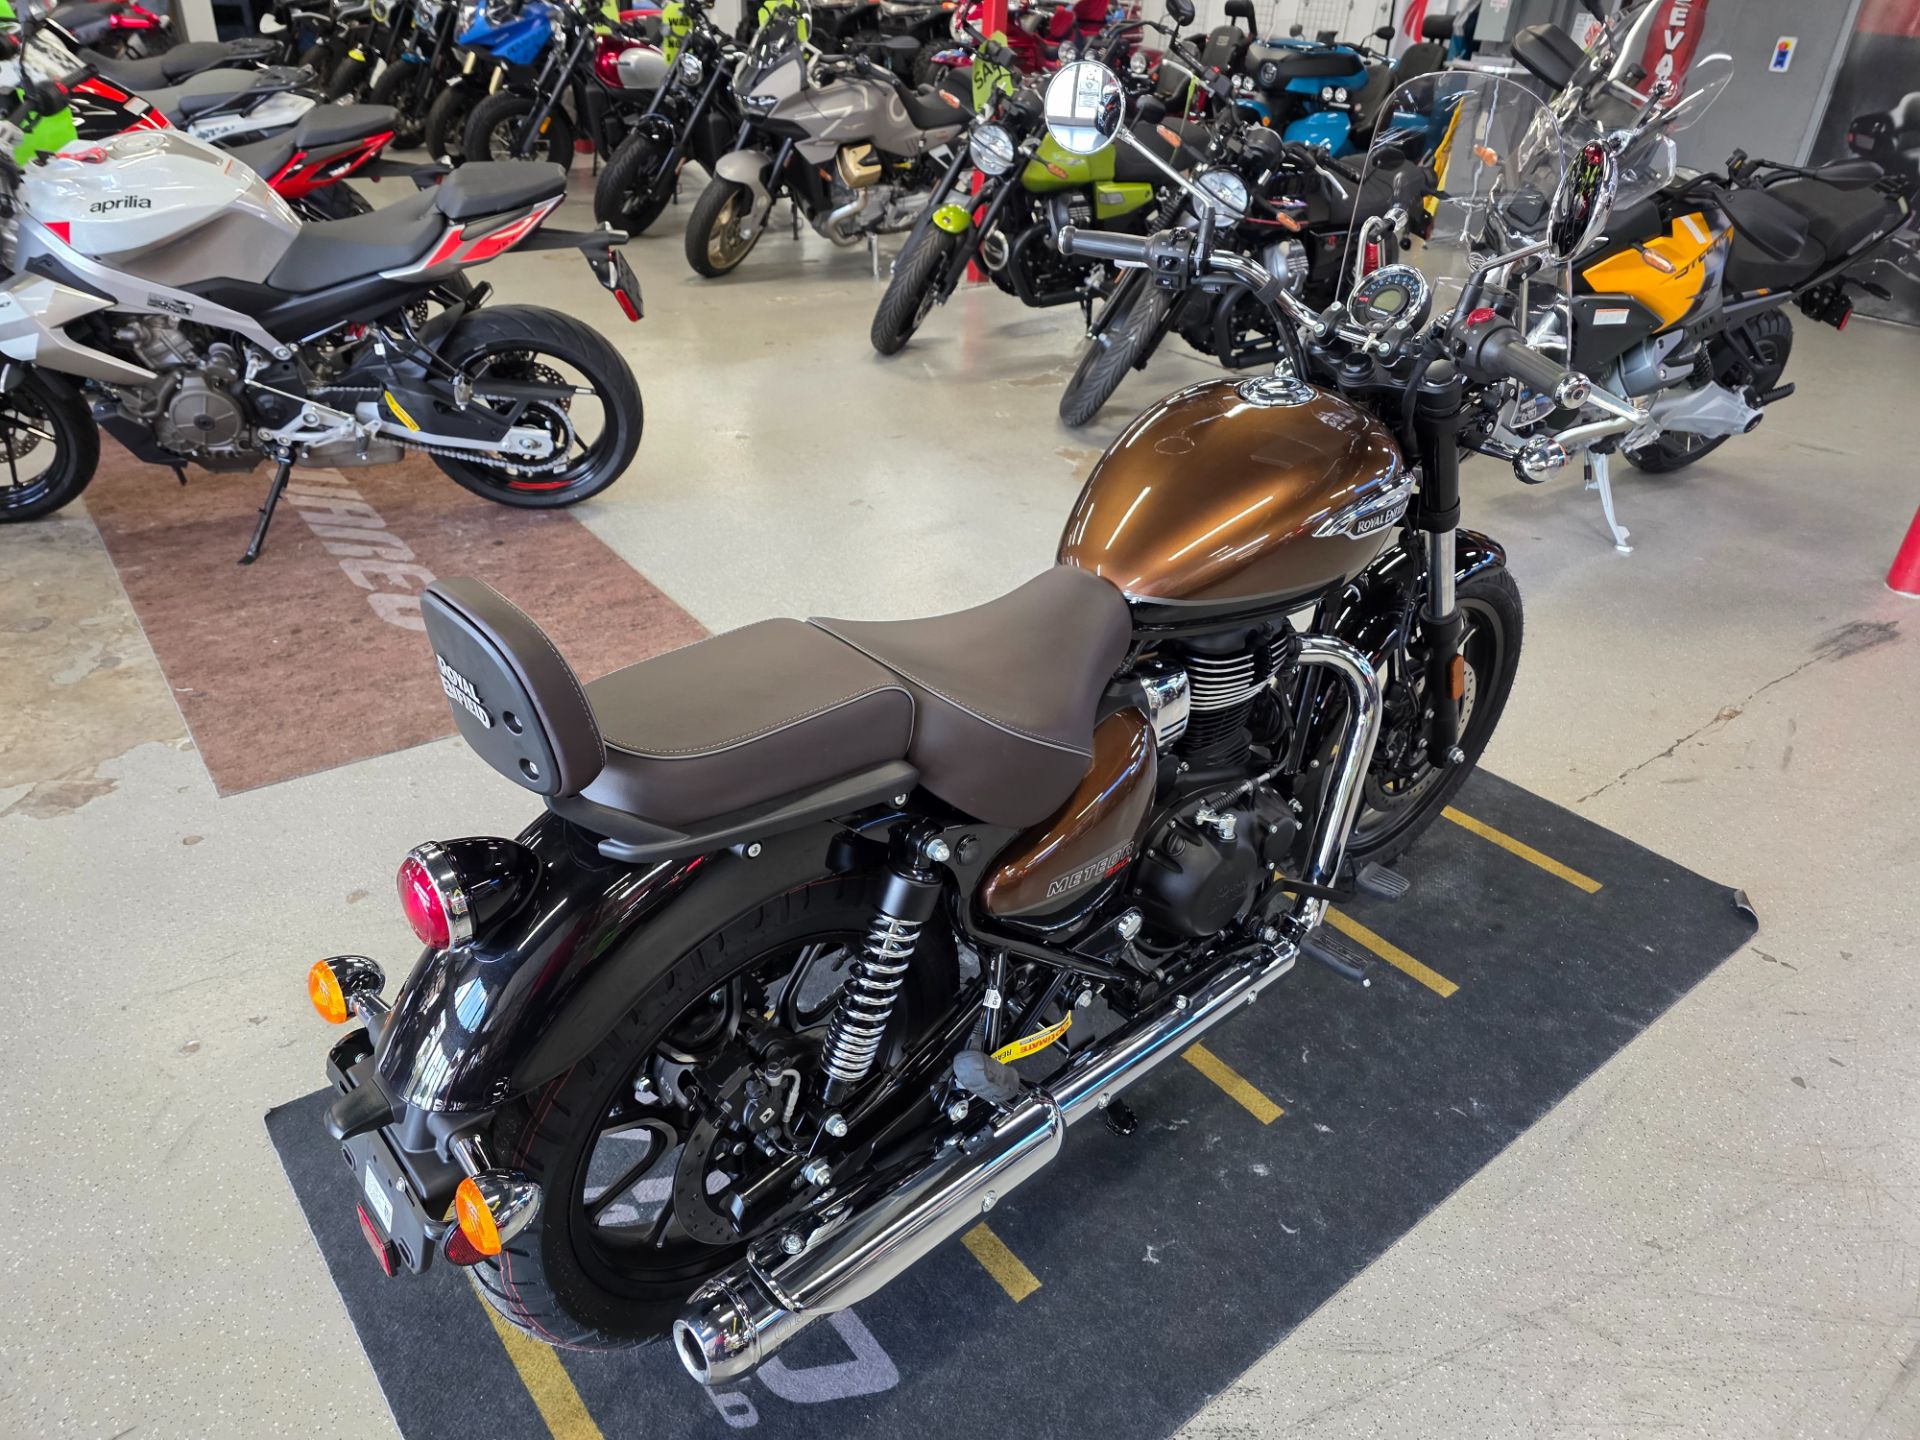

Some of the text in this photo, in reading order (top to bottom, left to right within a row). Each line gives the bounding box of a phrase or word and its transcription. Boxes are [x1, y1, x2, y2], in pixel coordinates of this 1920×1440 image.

[90, 196, 151, 213] aprilia
[1357, 515, 1385, 533] ROYAL
[436, 654, 481, 704] ROYAL
[440, 674, 491, 729] ENFIELD
[1046, 841, 1134, 898] METEOR
